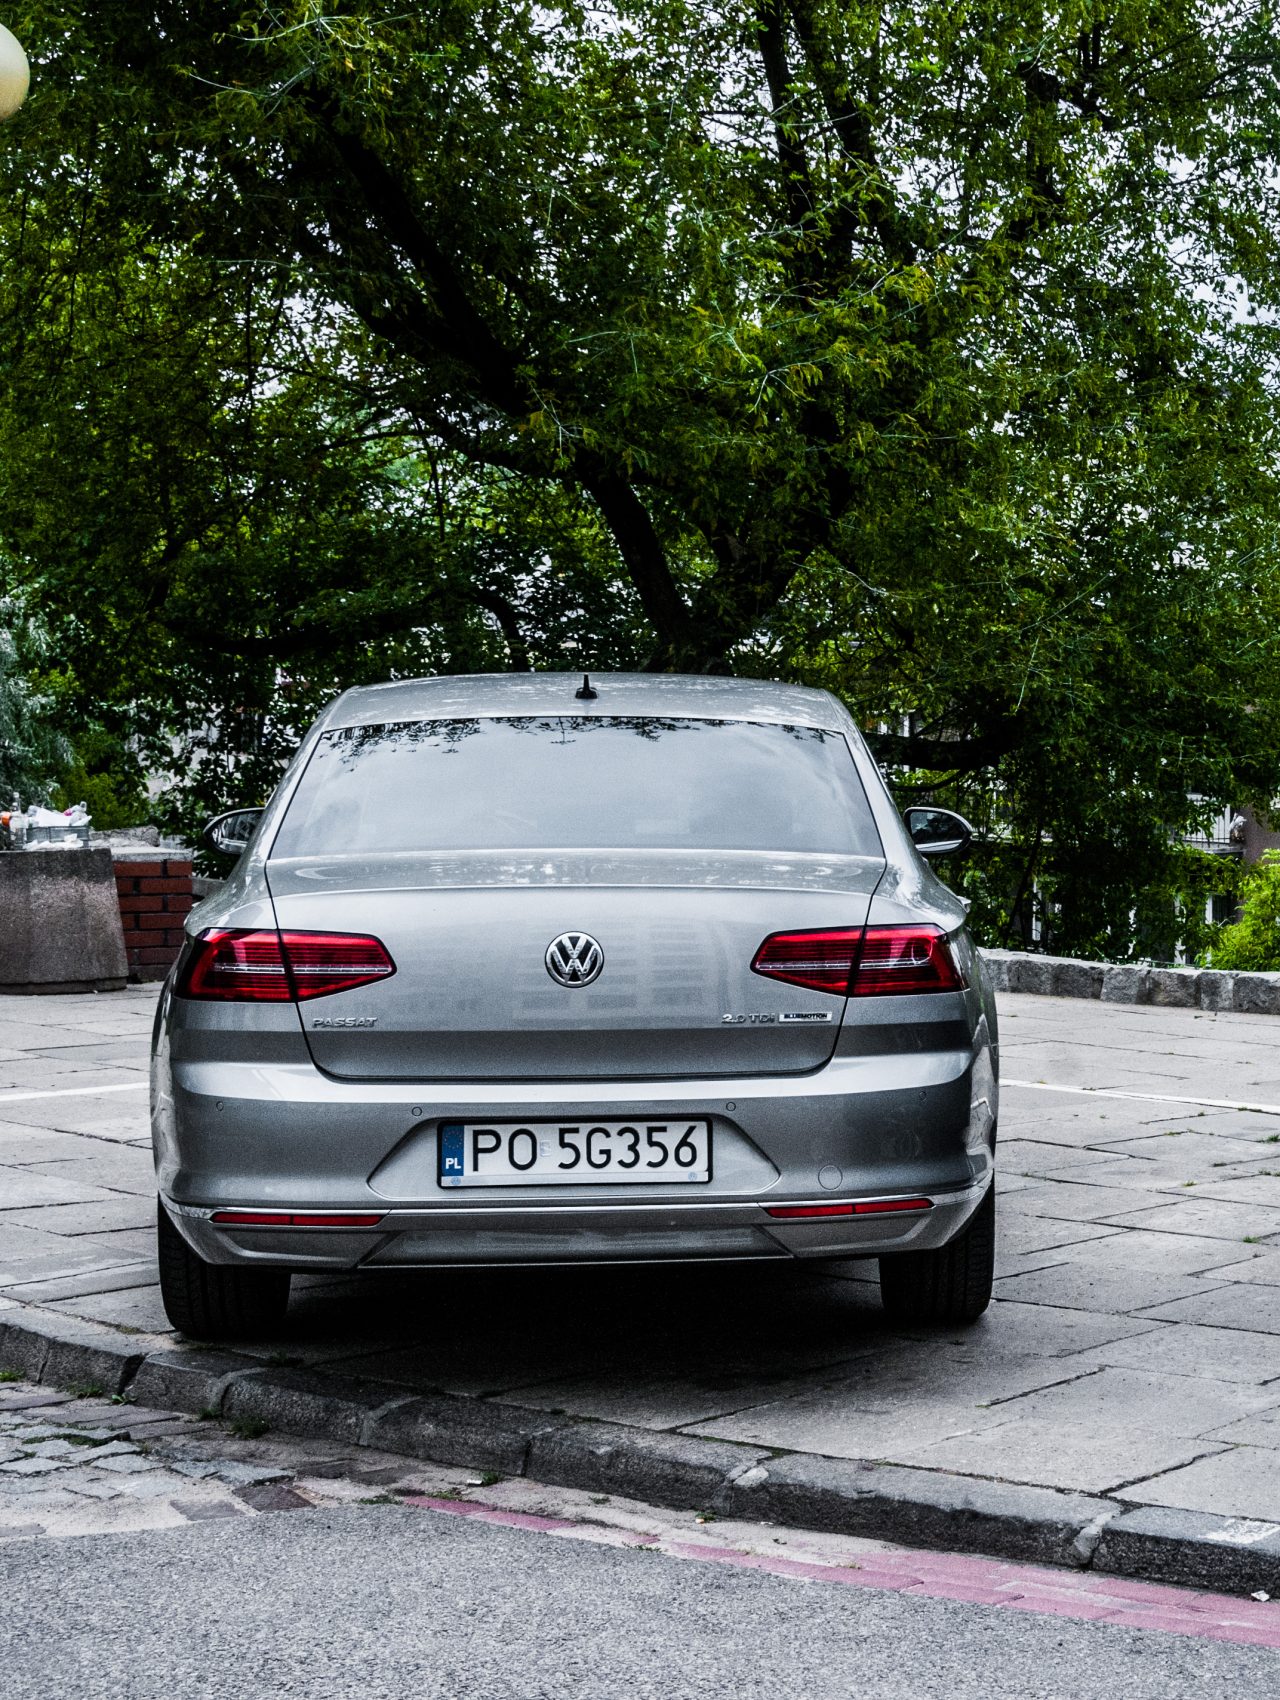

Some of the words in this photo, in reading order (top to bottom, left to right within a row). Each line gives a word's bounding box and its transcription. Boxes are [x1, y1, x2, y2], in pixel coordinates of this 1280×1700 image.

[312, 1016, 378, 1028] PASSAT
[721, 1013, 746, 1024] 2.0
[472, 1128, 538, 1172] PO
[558, 1125, 698, 1170] 5G356
[445, 1158, 461, 1170] PL
